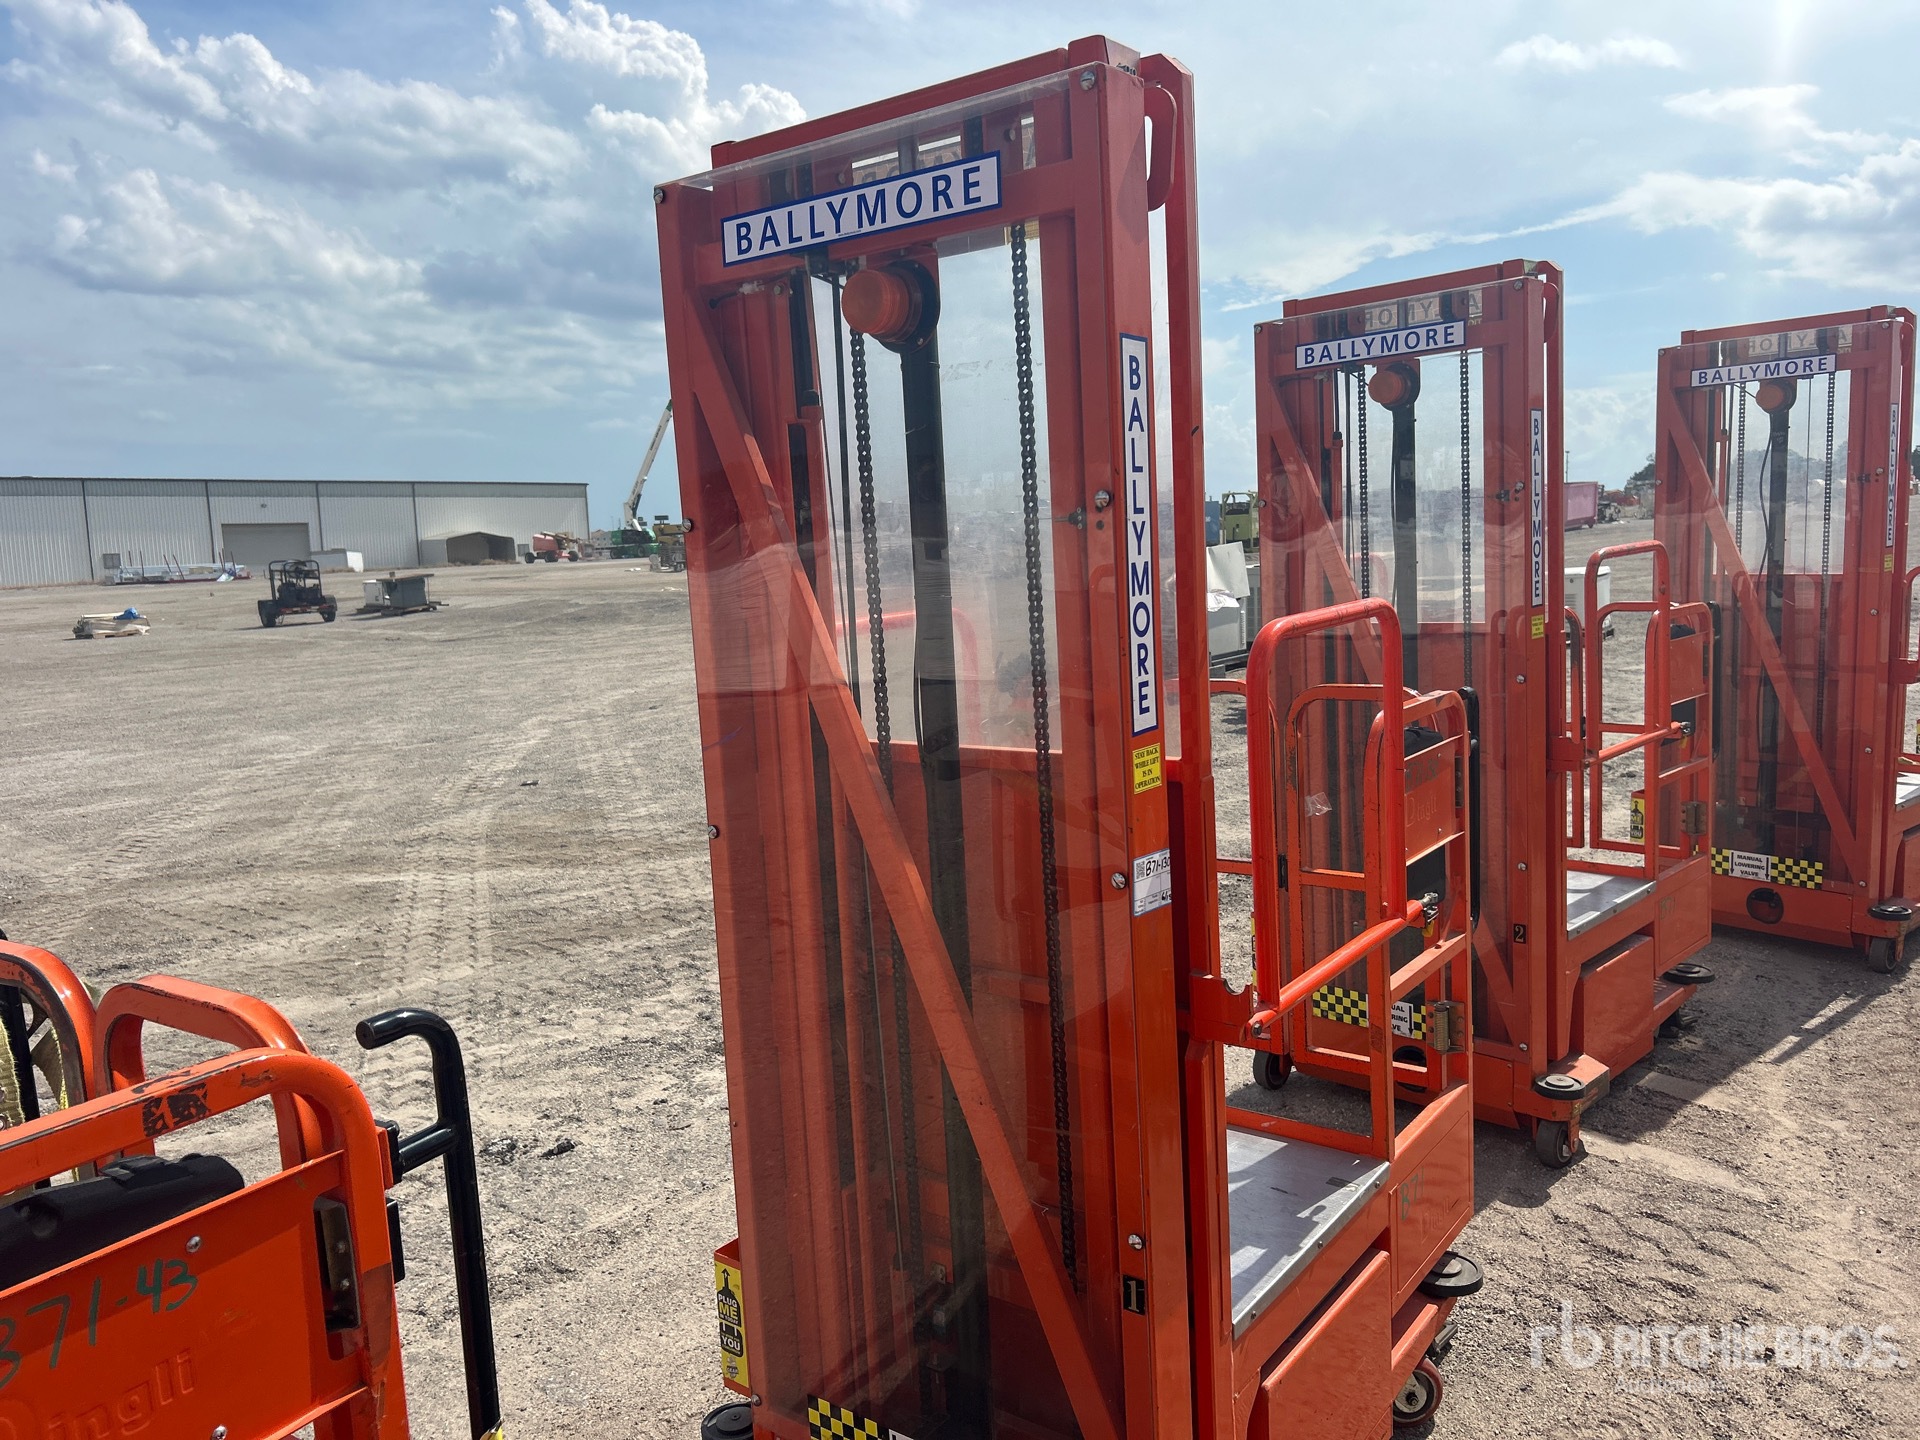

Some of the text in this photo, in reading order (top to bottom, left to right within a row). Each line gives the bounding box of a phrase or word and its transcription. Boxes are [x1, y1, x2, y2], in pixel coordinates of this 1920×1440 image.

[735, 165, 982, 256] BALLYMORE
[1304, 325, 1455, 365] BALLYMORE
[1698, 357, 1828, 385] BALLYMORE
[1532, 418, 1541, 598] BALLYMORE
[1127, 354, 1151, 716] BALLYMORE
[1734, 861, 1765, 871] LOWERING
[1737, 854, 1763, 863] MANUAL
[1740, 869, 1759, 877] VALVE
[1514, 925, 1524, 942] 2
[1391, 1003, 1405, 1013] UAL
[1391, 1014, 1408, 1023] RING
[717, 1293, 738, 1308] PLUG
[1127, 1280, 1140, 1312] 1
[719, 1301, 739, 1320] ME
[721, 1335, 741, 1351] YOU
